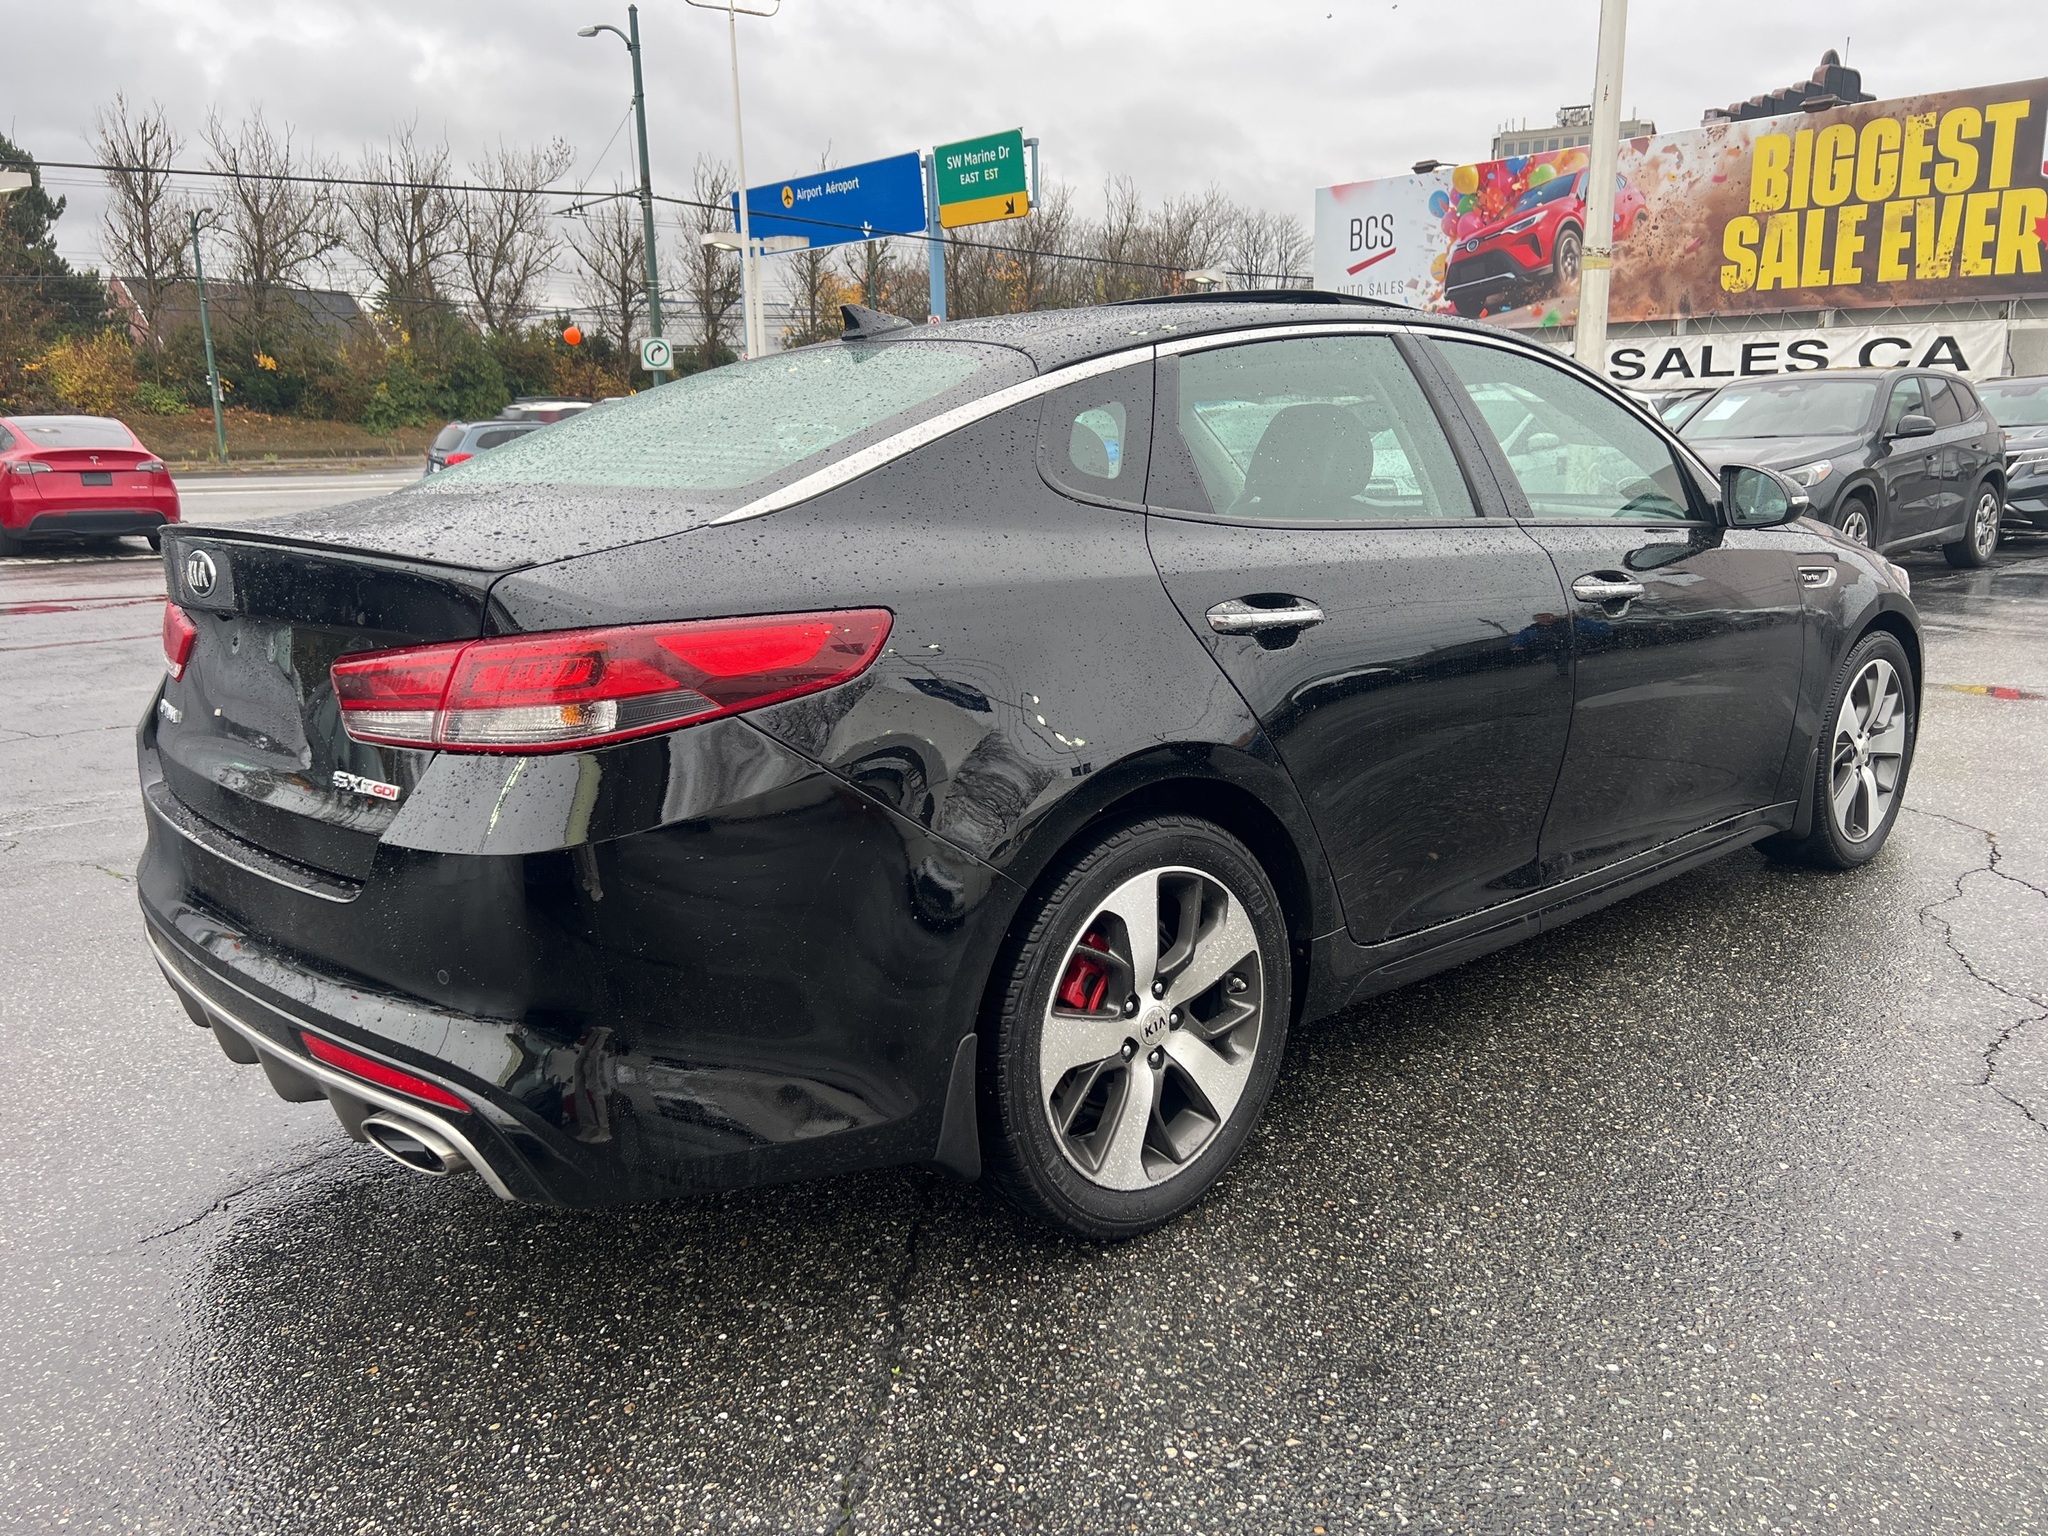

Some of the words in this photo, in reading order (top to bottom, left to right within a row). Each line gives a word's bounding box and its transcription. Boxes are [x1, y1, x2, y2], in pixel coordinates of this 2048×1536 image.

[946, 155, 962, 170] SW
[964, 150, 996, 166] Marine
[998, 146, 1010, 159] Dr
[1749, 100, 2030, 214] BIGGEST
[960, 171, 980, 185] EAST
[984, 168, 999, 181] EST
[797, 185, 822, 202] Airport
[826, 177, 859, 194] Aéroport
[1350, 213, 1394, 252] BCS
[1721, 204, 1868, 294] SALE
[1877, 187, 2048, 282] EVER
[1369, 281, 1404, 296] SALES
[1609, 338, 1830, 380] SALES
[1858, 335, 1972, 371] CA
[1801, 573, 1820, 581] Turbo
[1144, 1016, 1166, 1038] KIA
